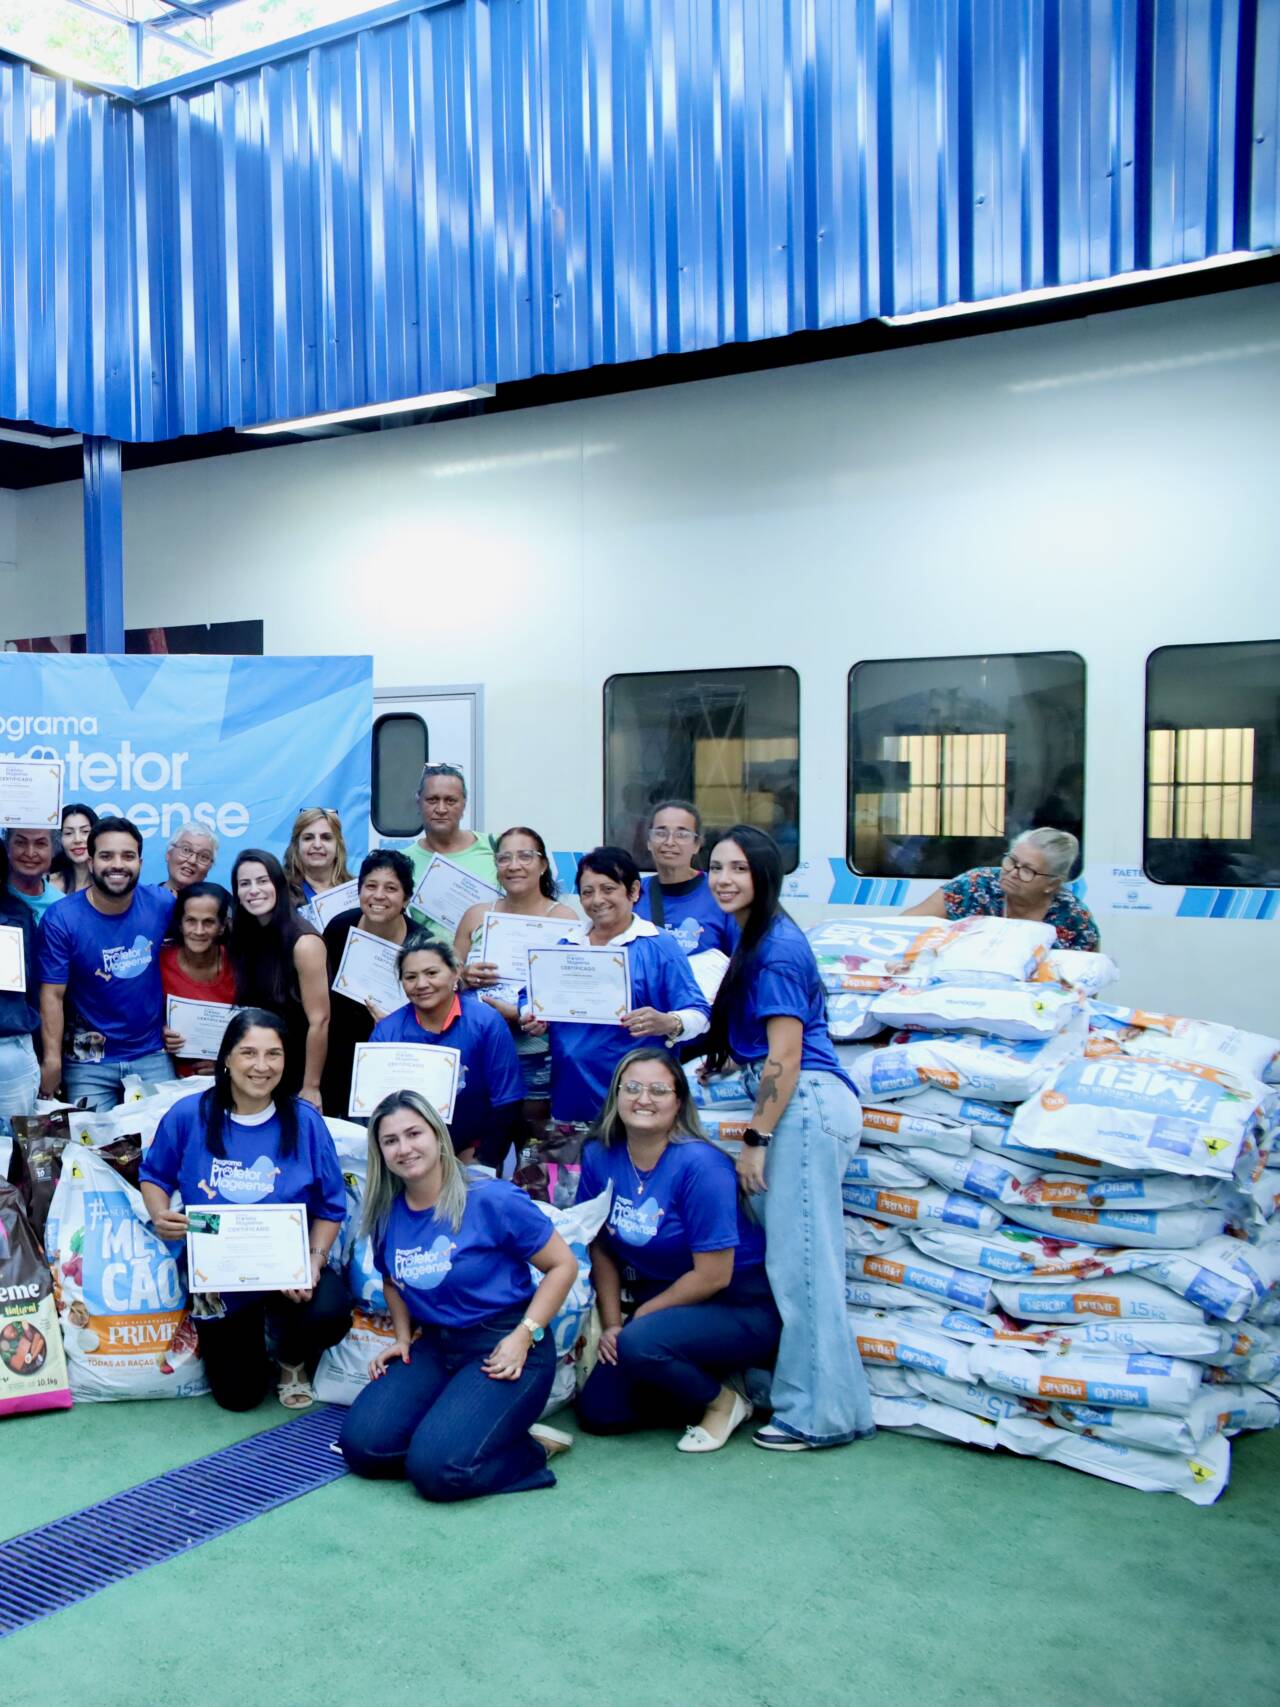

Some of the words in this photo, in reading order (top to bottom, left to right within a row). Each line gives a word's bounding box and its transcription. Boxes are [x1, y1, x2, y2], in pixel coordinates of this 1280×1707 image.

[1113, 868, 1145, 878] FAETE
[1079, 1062, 1199, 1101] MEU
[907, 1118, 922, 1131] 15
[210, 1163, 262, 1181] Protetor
[209, 1176, 275, 1194] Mageense
[395, 1260, 453, 1280] Mageense
[102, 1255, 182, 1312] CÃO
[4, 1302, 38, 1316] Natural
[1077, 1299, 1117, 1313] PRIME
[1130, 1301, 1149, 1316] 15
[1150, 1309, 1167, 1320] kg
[1084, 1324, 1111, 1343] 15
[1114, 1330, 1134, 1346] kg
[88, 1358, 114, 1368] TODAS
[115, 1359, 126, 1368] AS
[127, 1358, 155, 1369] RAÇAS
[175, 1381, 193, 1397] 15
[1010, 1376, 1029, 1391] 15
[986, 1396, 1016, 1419] 15
